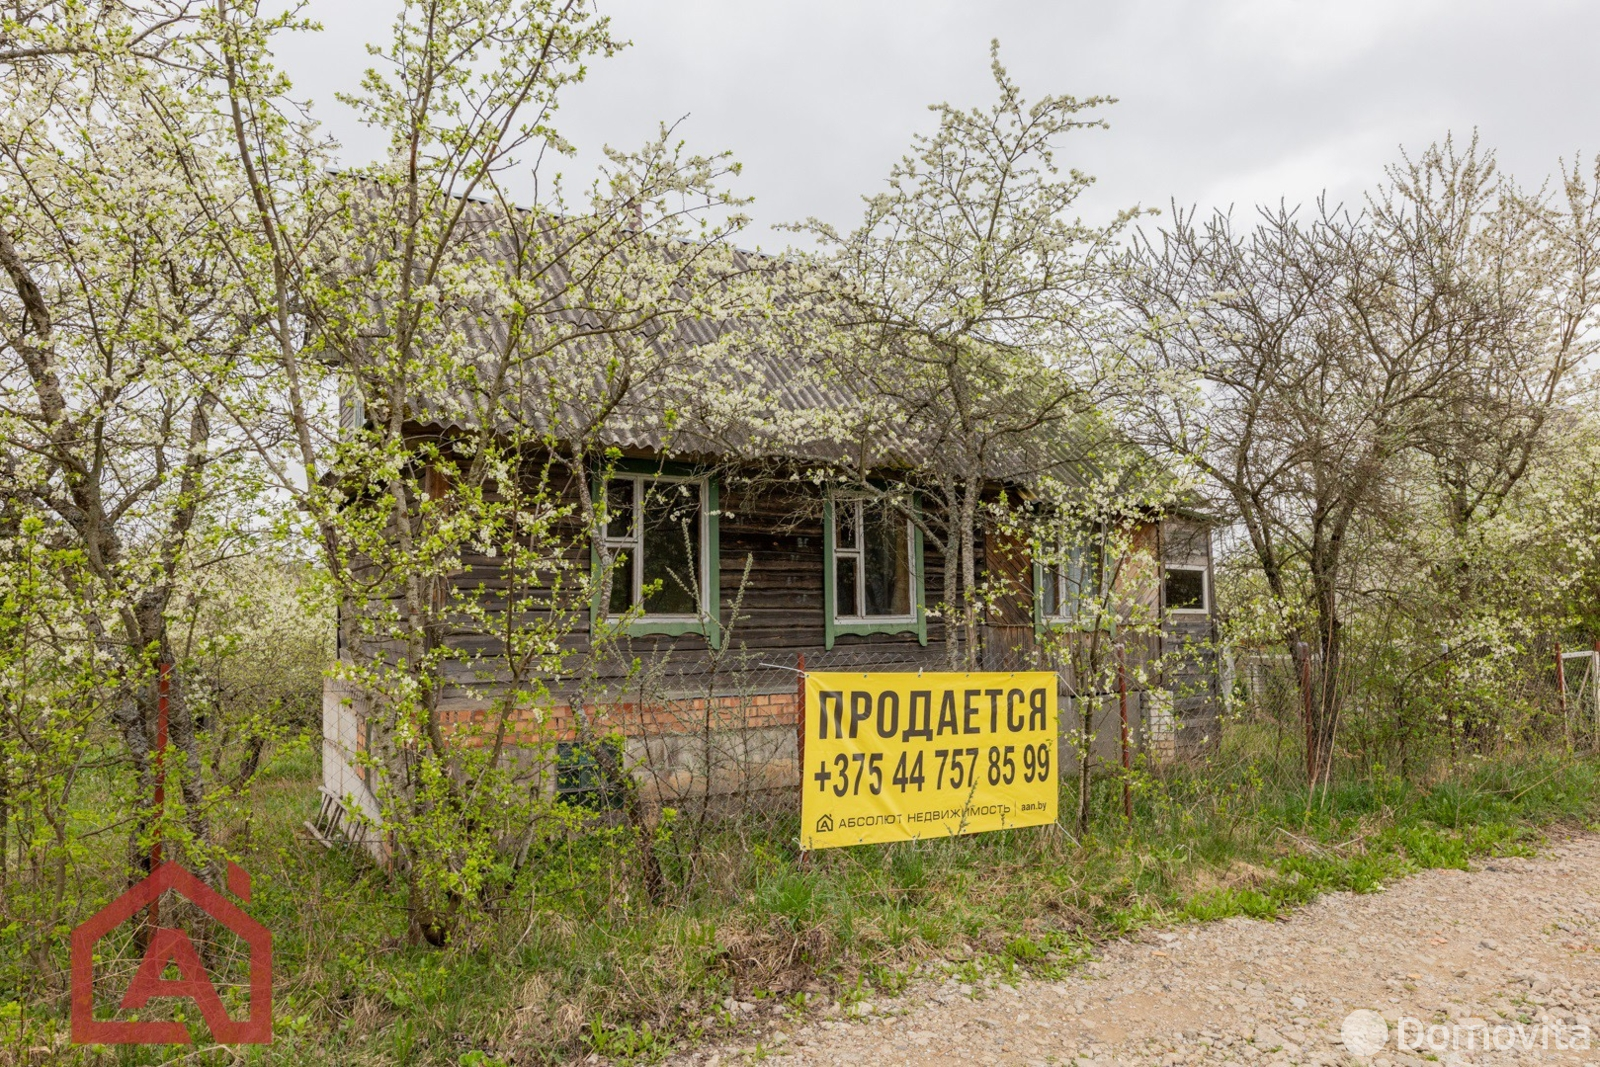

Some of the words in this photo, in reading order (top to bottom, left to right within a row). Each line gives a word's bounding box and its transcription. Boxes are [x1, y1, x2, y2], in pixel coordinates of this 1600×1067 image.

[818, 688, 1046, 742] ПРОДАЕТСЯ
[814, 752, 884, 798] +375
[892, 750, 925, 793] 44
[935, 747, 979, 790] 757
[988, 745, 1015, 786] 85
[1023, 743, 1050, 783] 99
[838, 814, 903, 829] АБСОЛЮТ
[907, 804, 1011, 823] НЕДВИЖИМОСТЬ
[1021, 801, 1047, 812] aan.by
